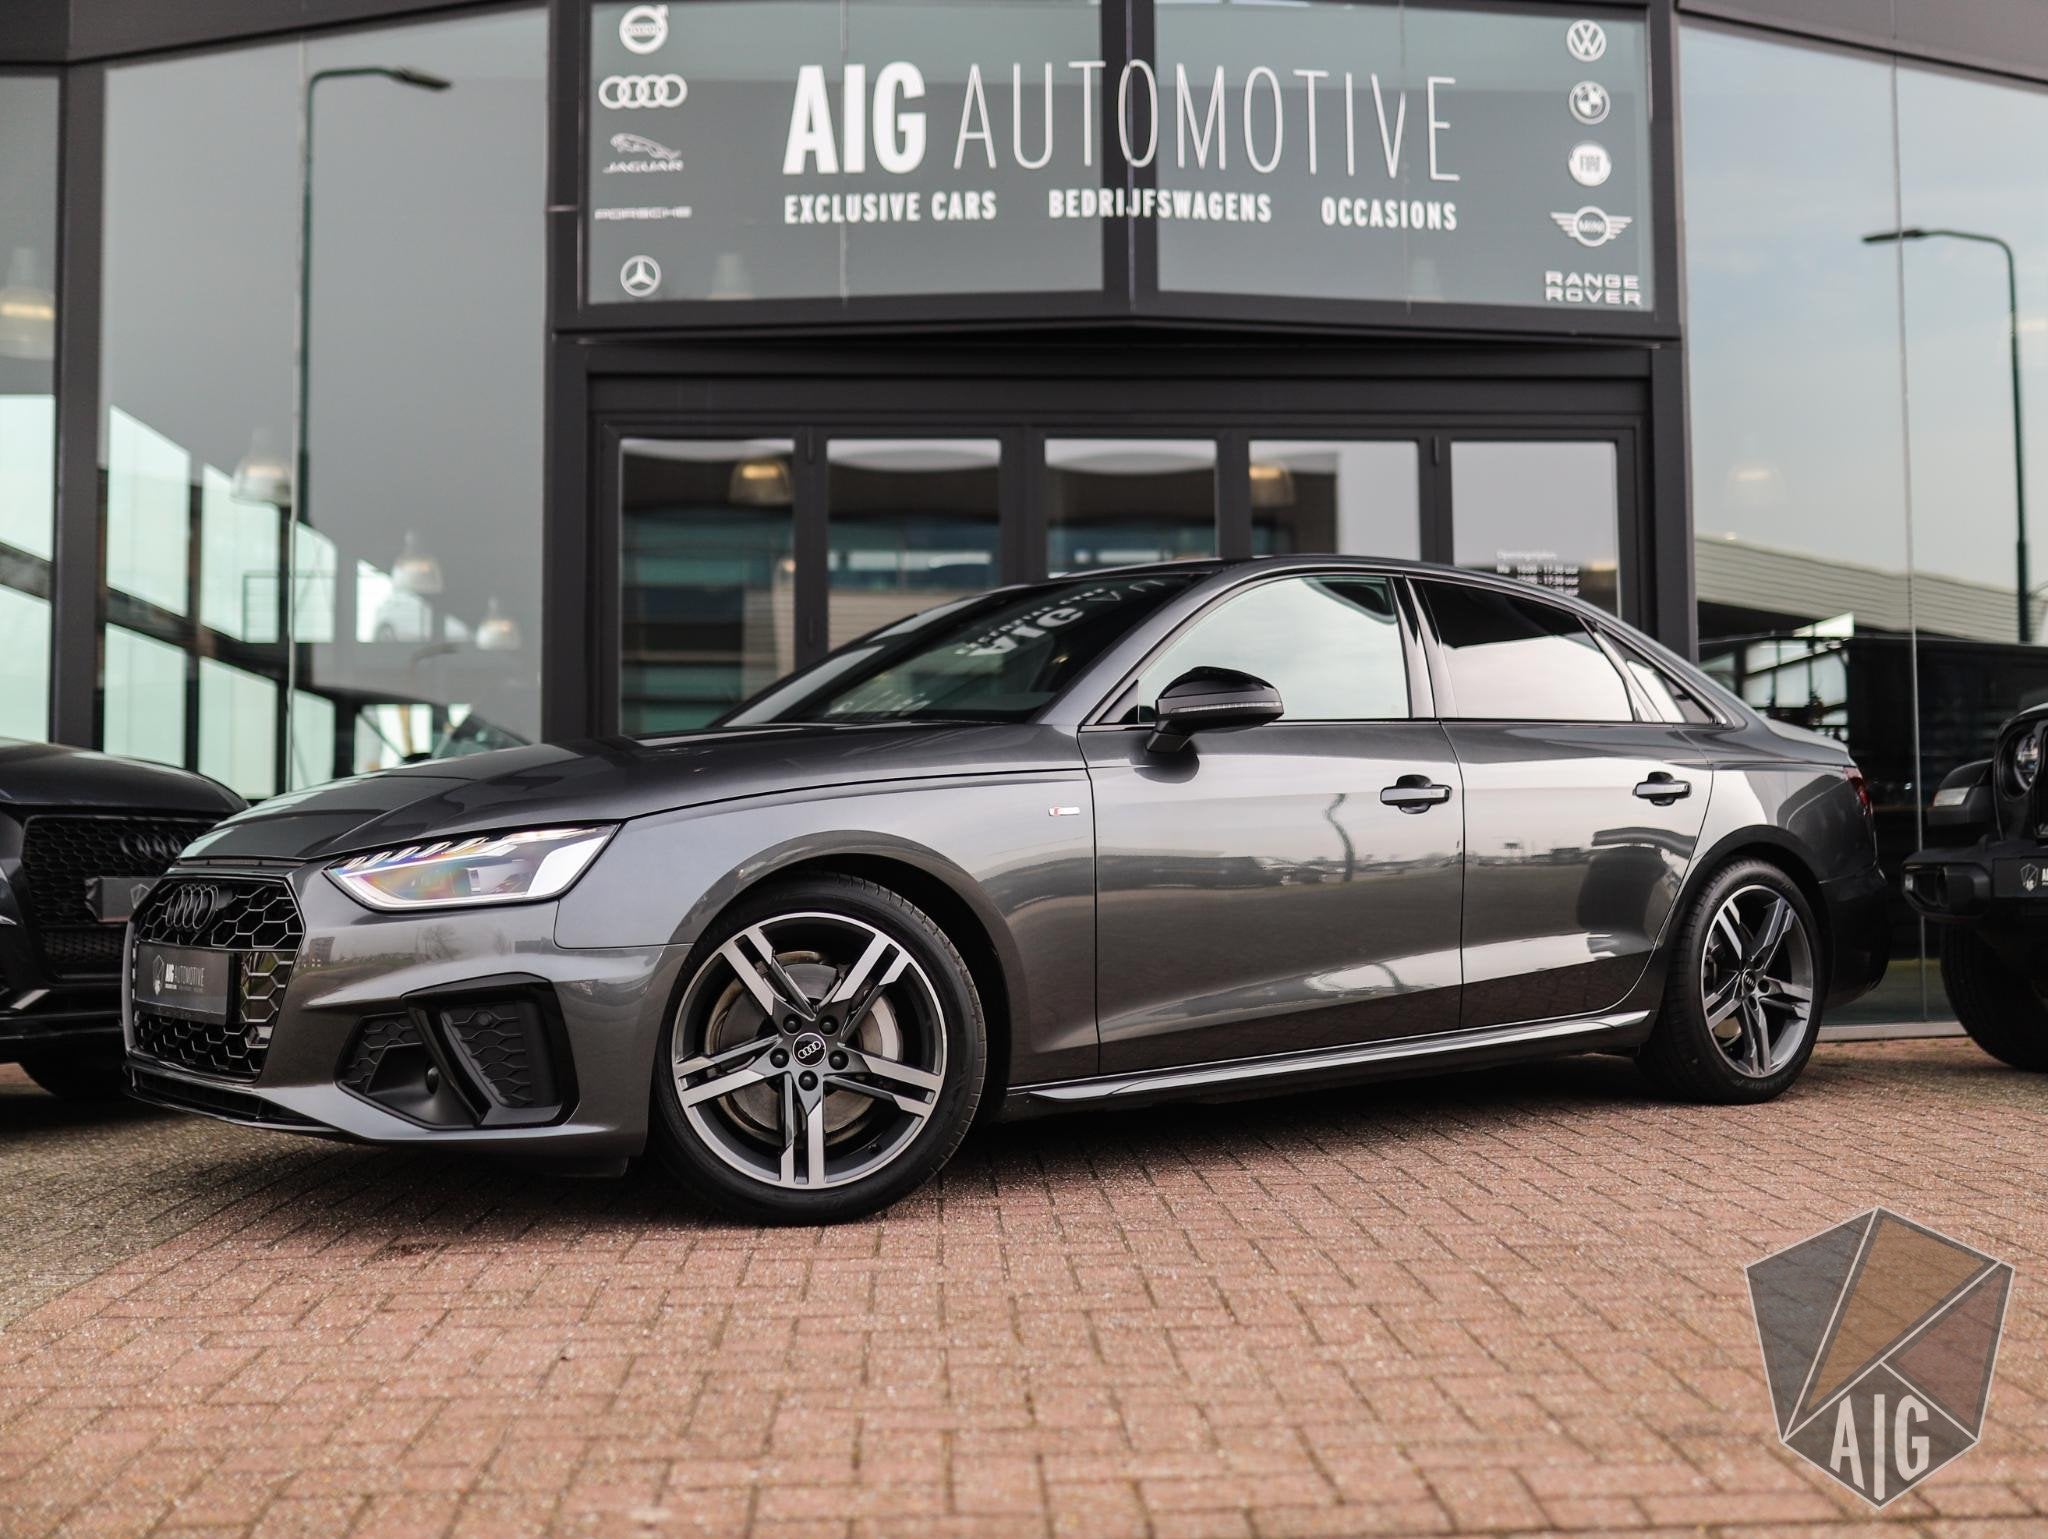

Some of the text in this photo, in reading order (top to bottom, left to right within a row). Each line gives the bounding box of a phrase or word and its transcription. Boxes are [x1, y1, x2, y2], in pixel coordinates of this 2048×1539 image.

[782, 59, 1460, 181] AIG AUTOMOTIVE
[784, 192, 997, 224] EXCLUSIVE CARS
[1048, 189, 1272, 223] BEDRIJFSWAGENS
[1321, 197, 1457, 230] OCCASIONS
[1545, 270, 1639, 289] RANGE
[1545, 286, 1641, 306] ROVER
